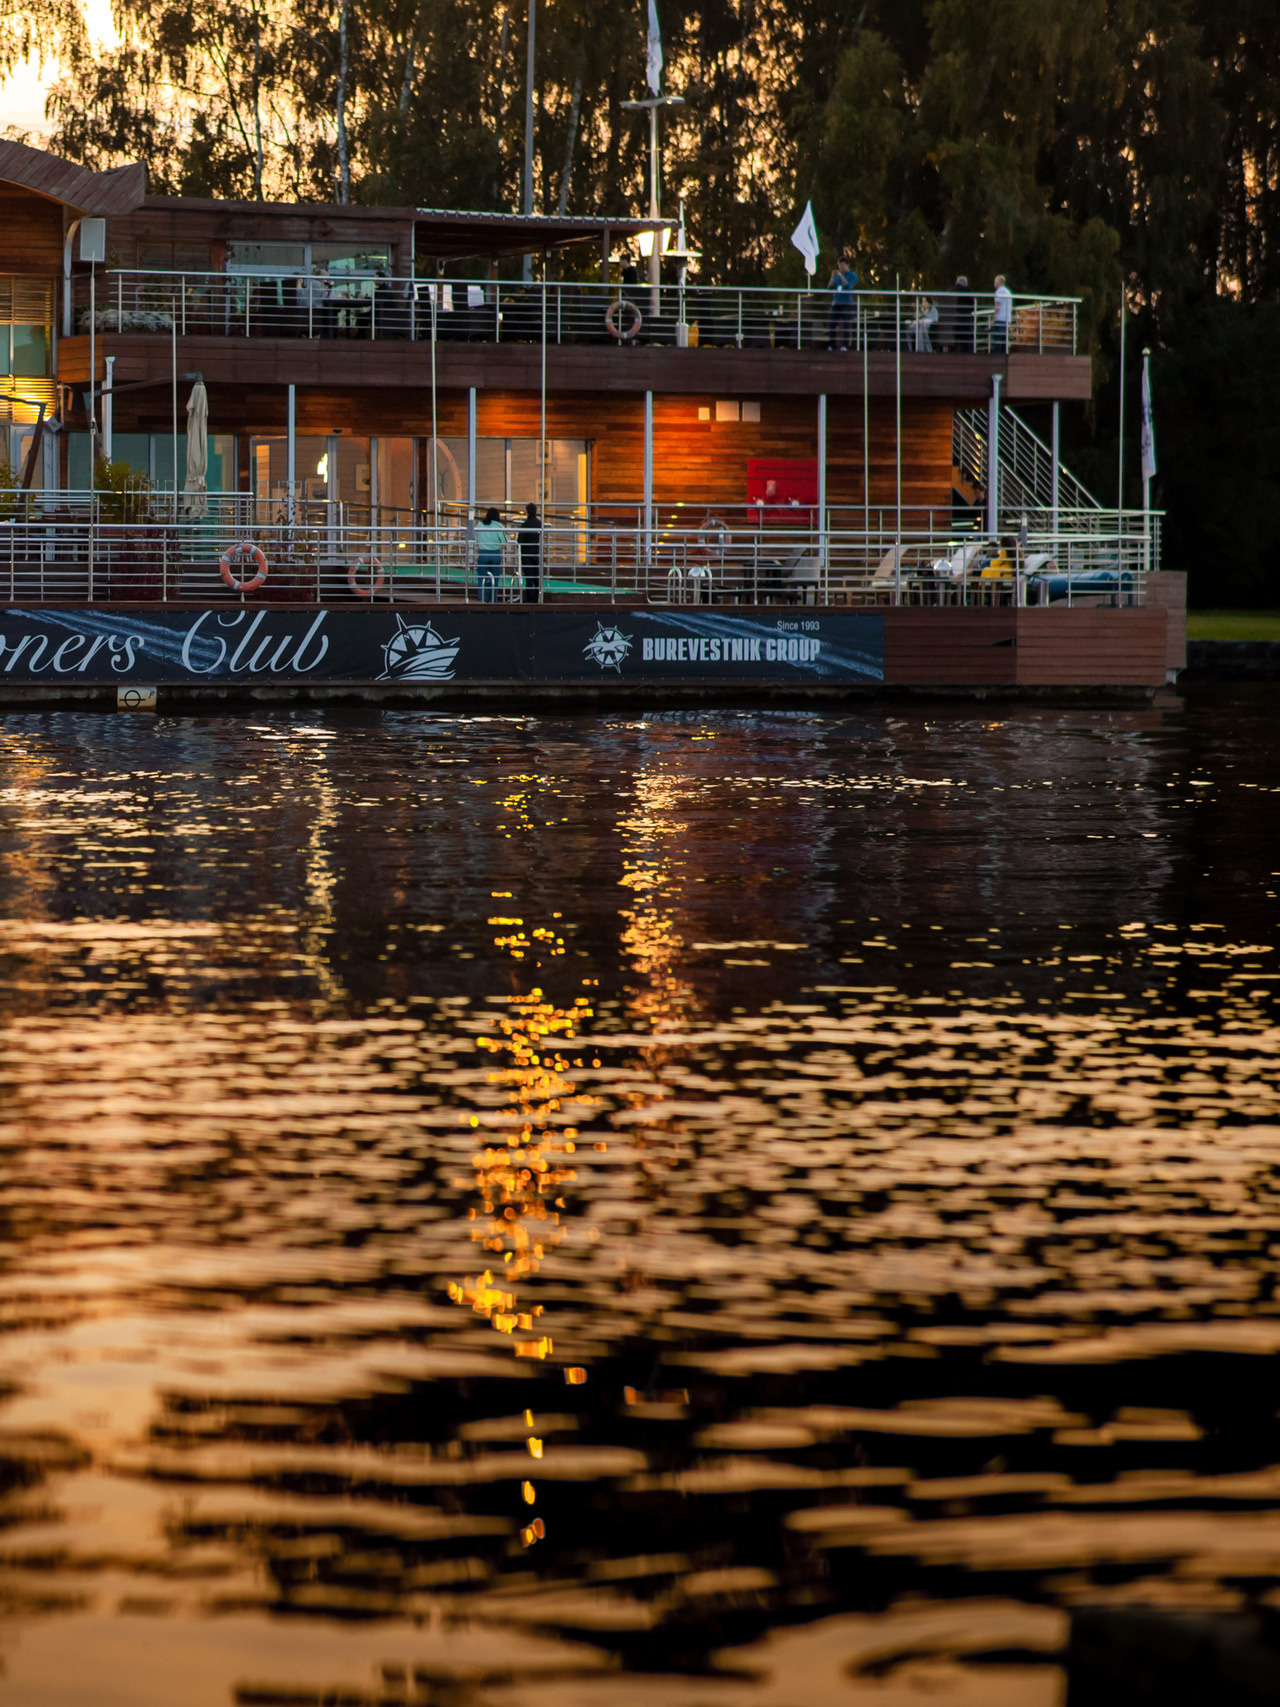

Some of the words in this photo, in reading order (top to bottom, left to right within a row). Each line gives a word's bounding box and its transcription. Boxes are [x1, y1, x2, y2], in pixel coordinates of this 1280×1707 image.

[777, 620, 798, 631] Since
[800, 620, 819, 631] 1993
[181, 610, 328, 673] Club
[642, 638, 760, 661] BUREVESTNIK
[766, 638, 820, 661] GROUP
